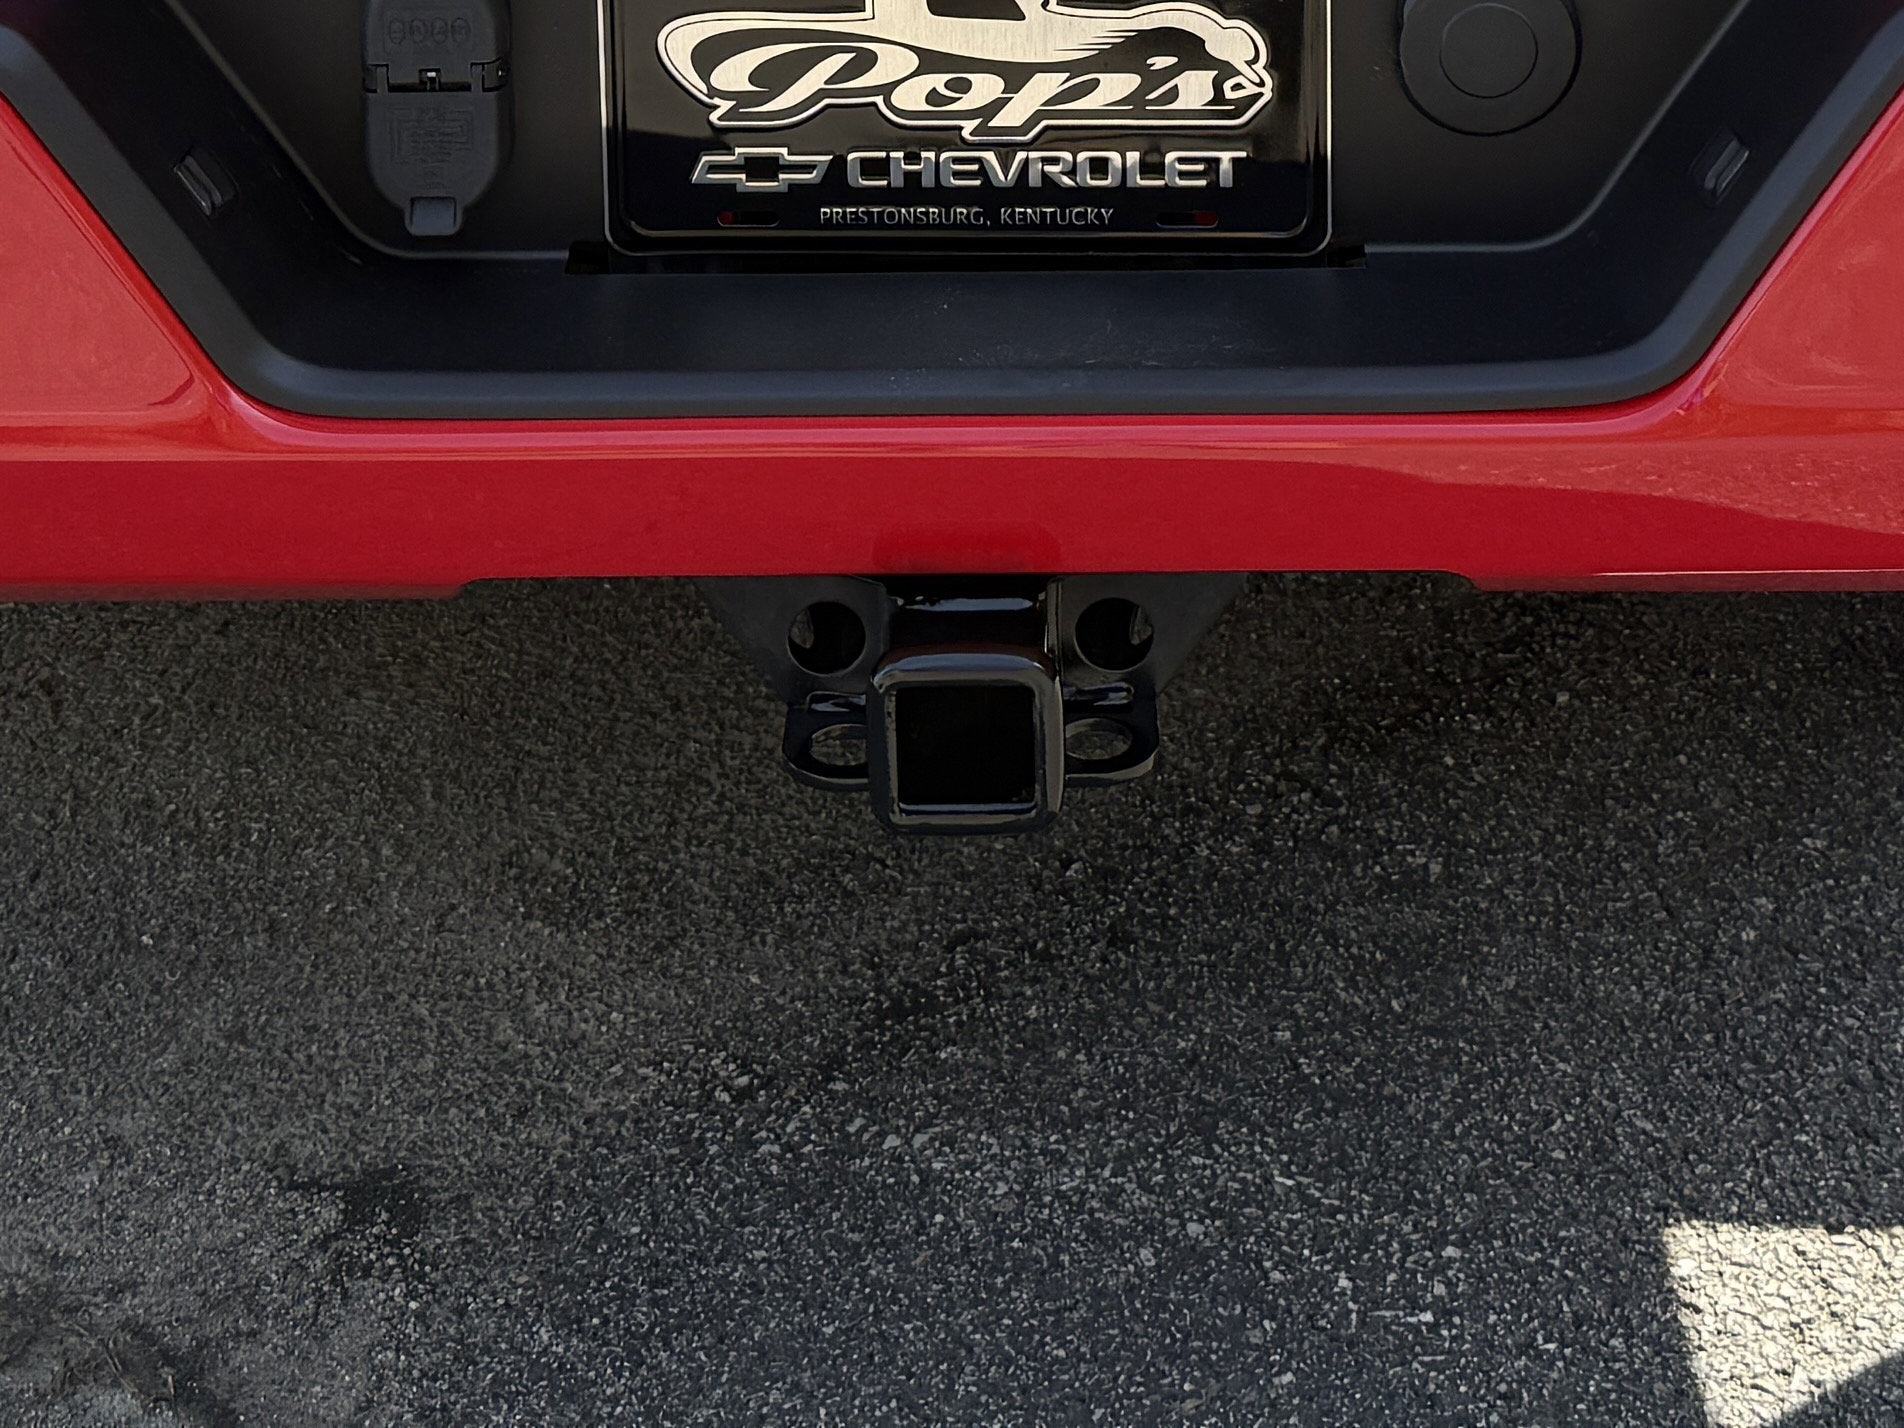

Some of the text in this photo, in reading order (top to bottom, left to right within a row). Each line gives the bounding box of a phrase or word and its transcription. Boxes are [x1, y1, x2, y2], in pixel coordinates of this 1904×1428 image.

[709, 42, 1236, 128] Pop's
[846, 150, 1248, 189] CHEVROLET
[819, 206, 1114, 228] PRESTONSBURG, KENTUCKY
